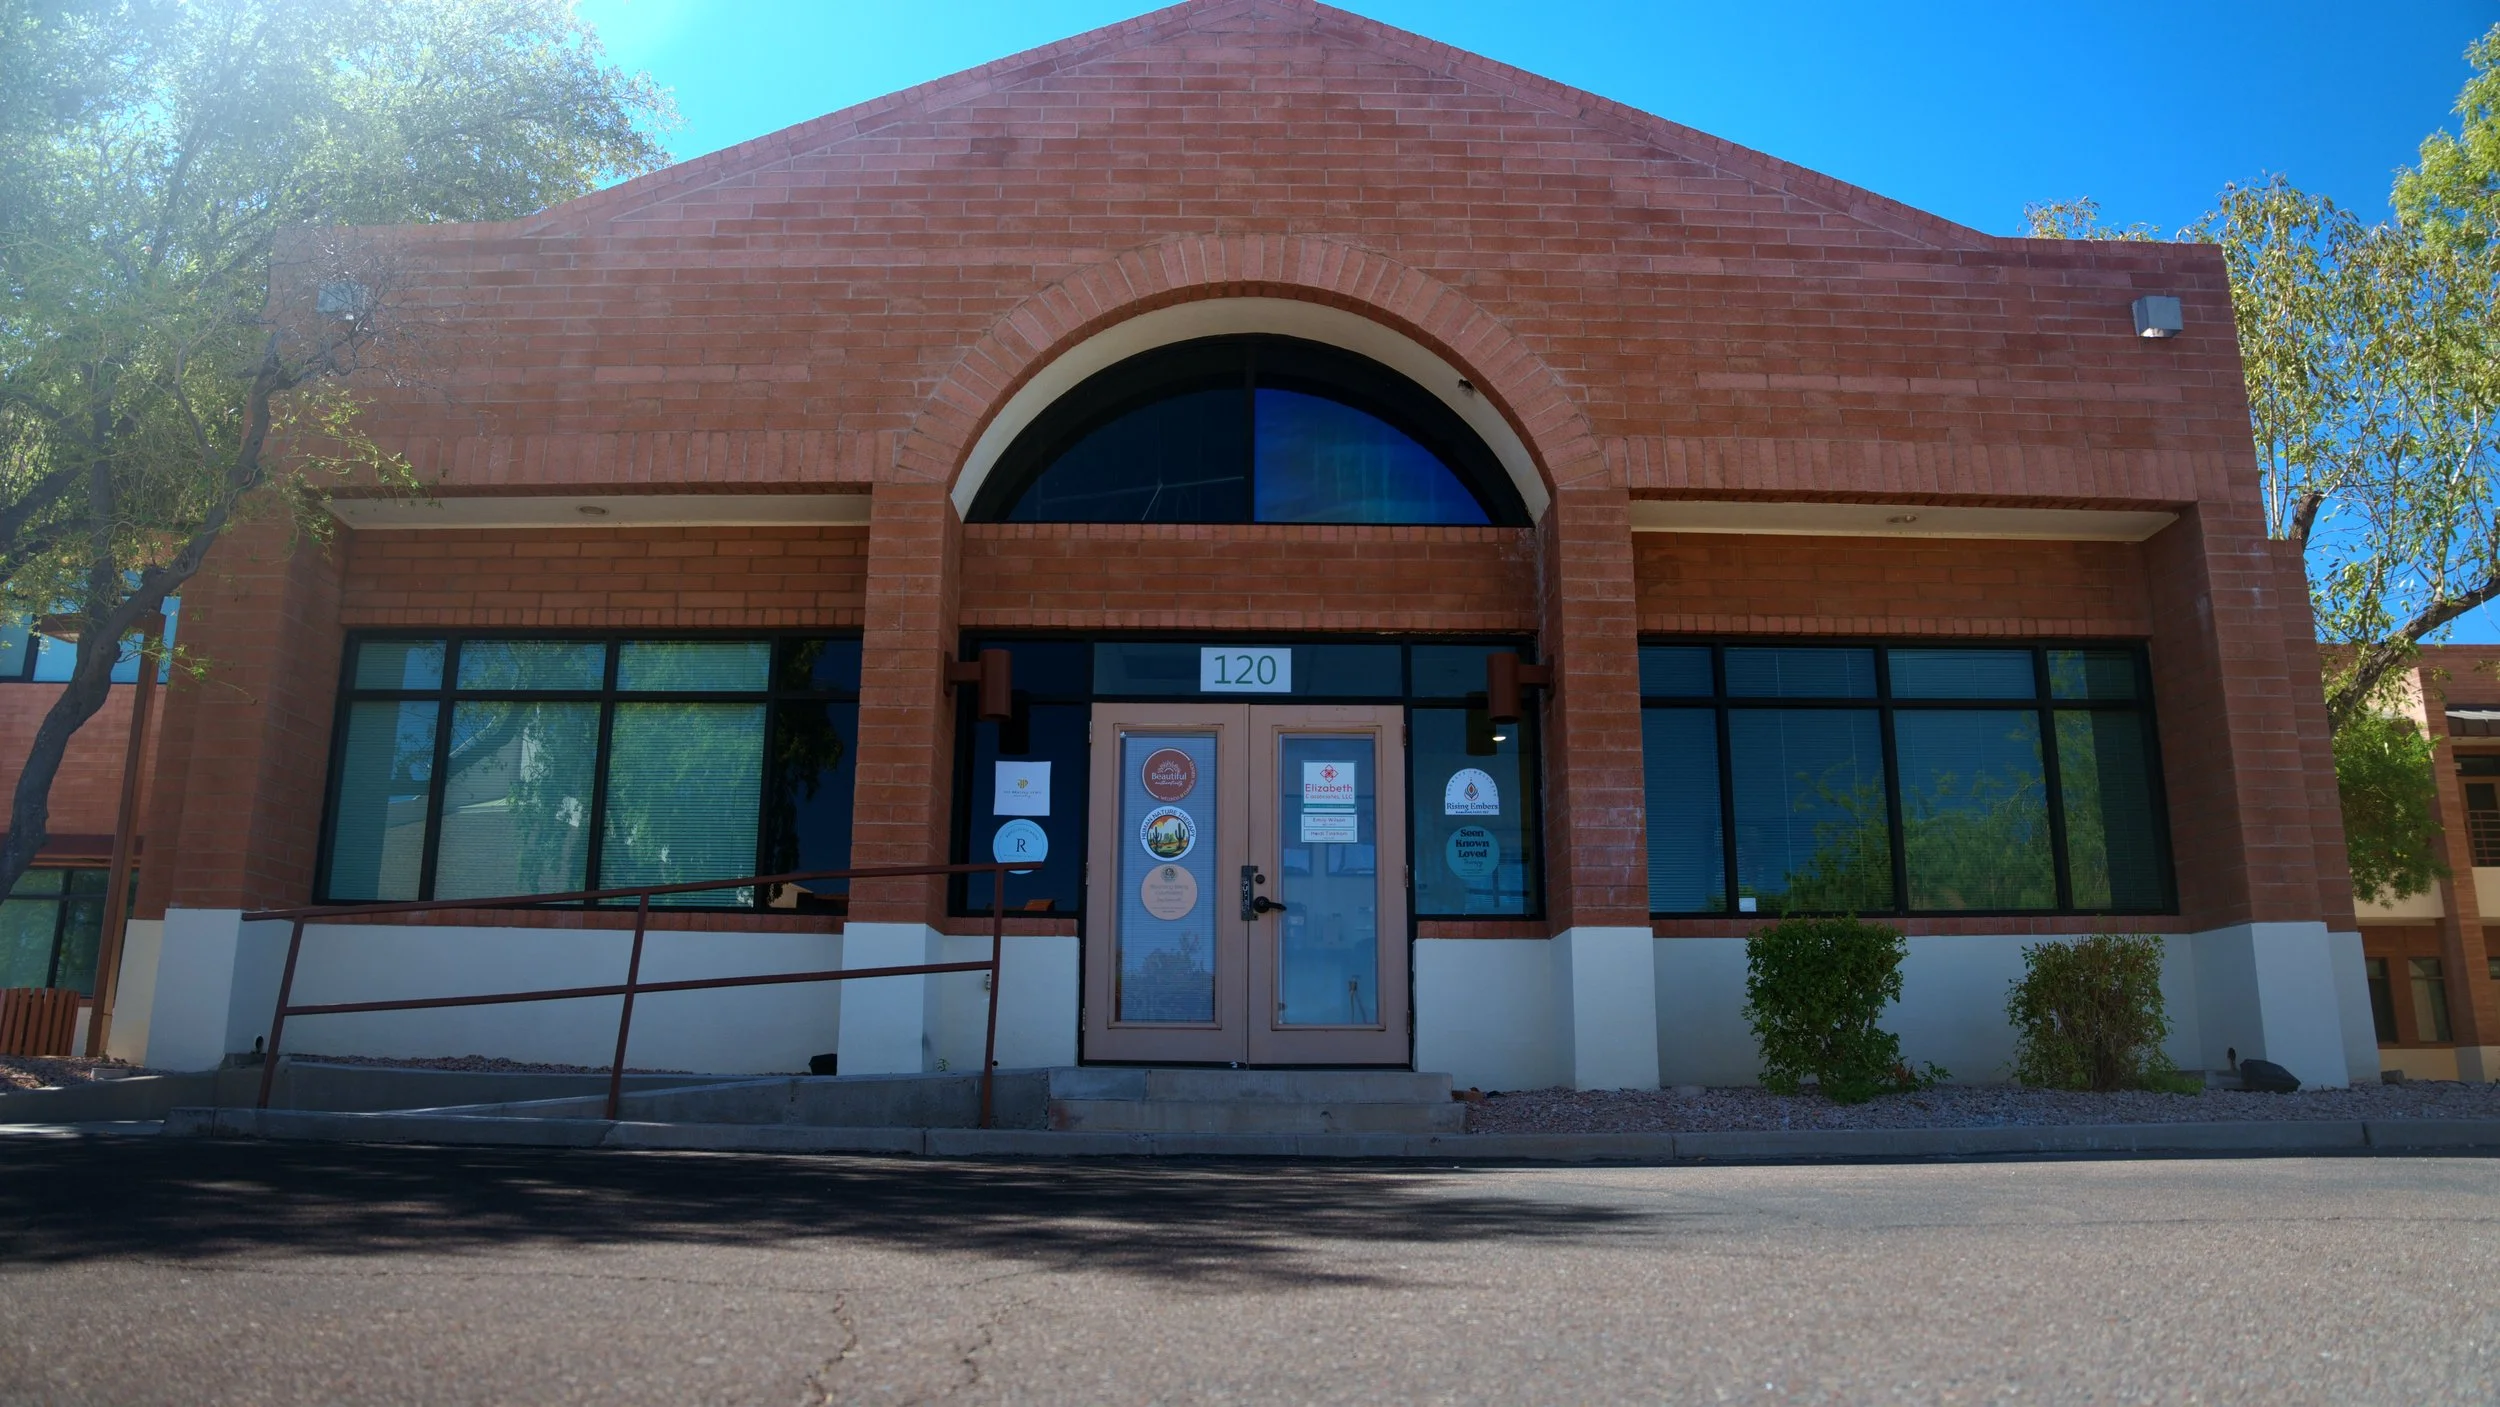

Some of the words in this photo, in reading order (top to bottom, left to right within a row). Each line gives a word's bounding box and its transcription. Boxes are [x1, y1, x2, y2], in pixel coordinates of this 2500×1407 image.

[1214, 654, 1276, 685] 120
[1151, 772, 1187, 780] Beautiful
[1305, 783, 1353, 793] Elizabeth
[1446, 802, 1469, 811] Rising
[1470, 802, 1498, 810] Embers
[1141, 817, 1154, 840] HUMAN
[1152, 808, 1177, 819] NATURE
[1178, 812, 1196, 838] THERAPY
[1460, 829, 1484, 837] Seen
[1016, 838, 1027, 852] R
[1455, 839, 1489, 847] Known
[1458, 849, 1487, 858] Loved
